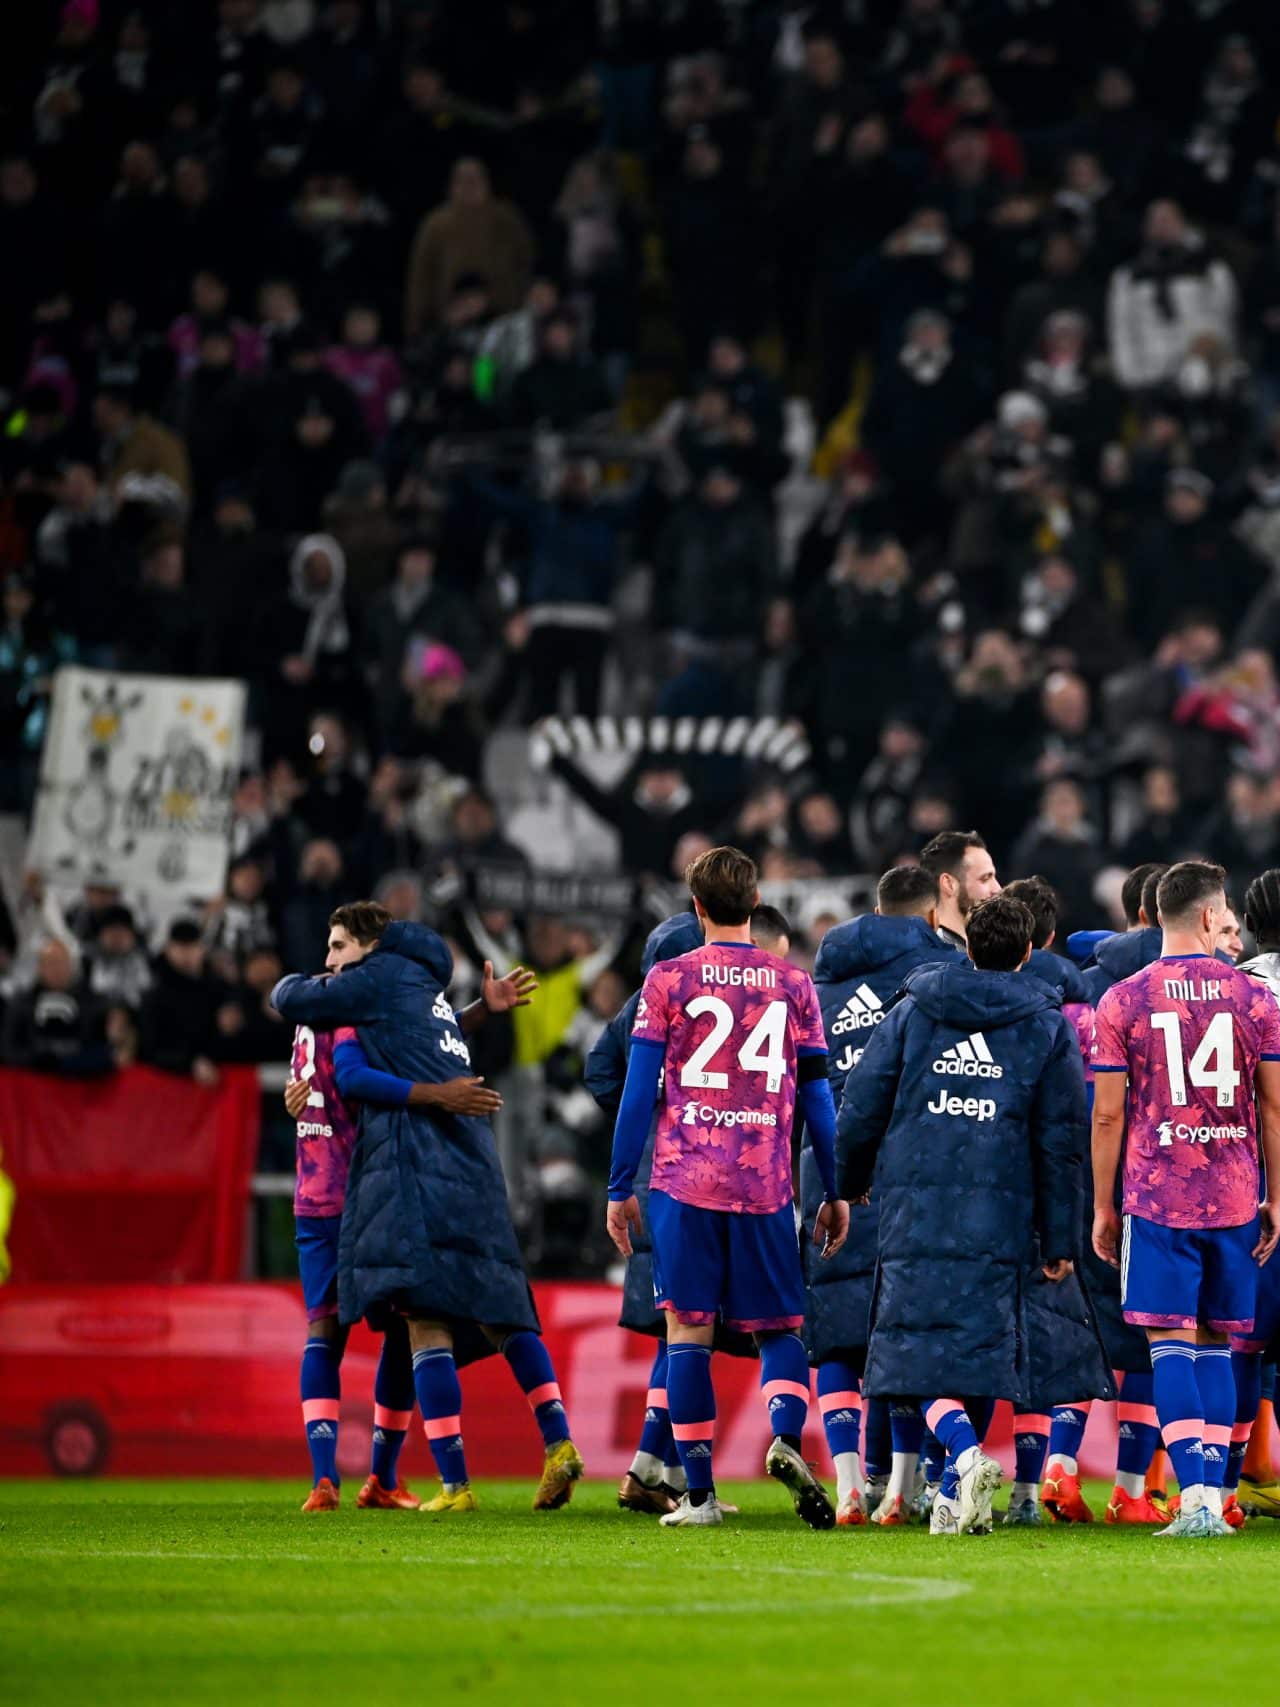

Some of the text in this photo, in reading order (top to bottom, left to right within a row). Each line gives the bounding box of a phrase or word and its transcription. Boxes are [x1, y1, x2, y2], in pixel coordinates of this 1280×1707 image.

[702, 964, 776, 988] RUGANI
[1164, 979, 1221, 1000] MILIK
[681, 995, 787, 1093] 24
[933, 1058, 1003, 1079] adidas
[1151, 1012, 1240, 1106] 14
[928, 1089, 996, 1121] Jeep
[699, 1106, 776, 1128] Cygames
[1175, 1124, 1248, 1144] Cygames
